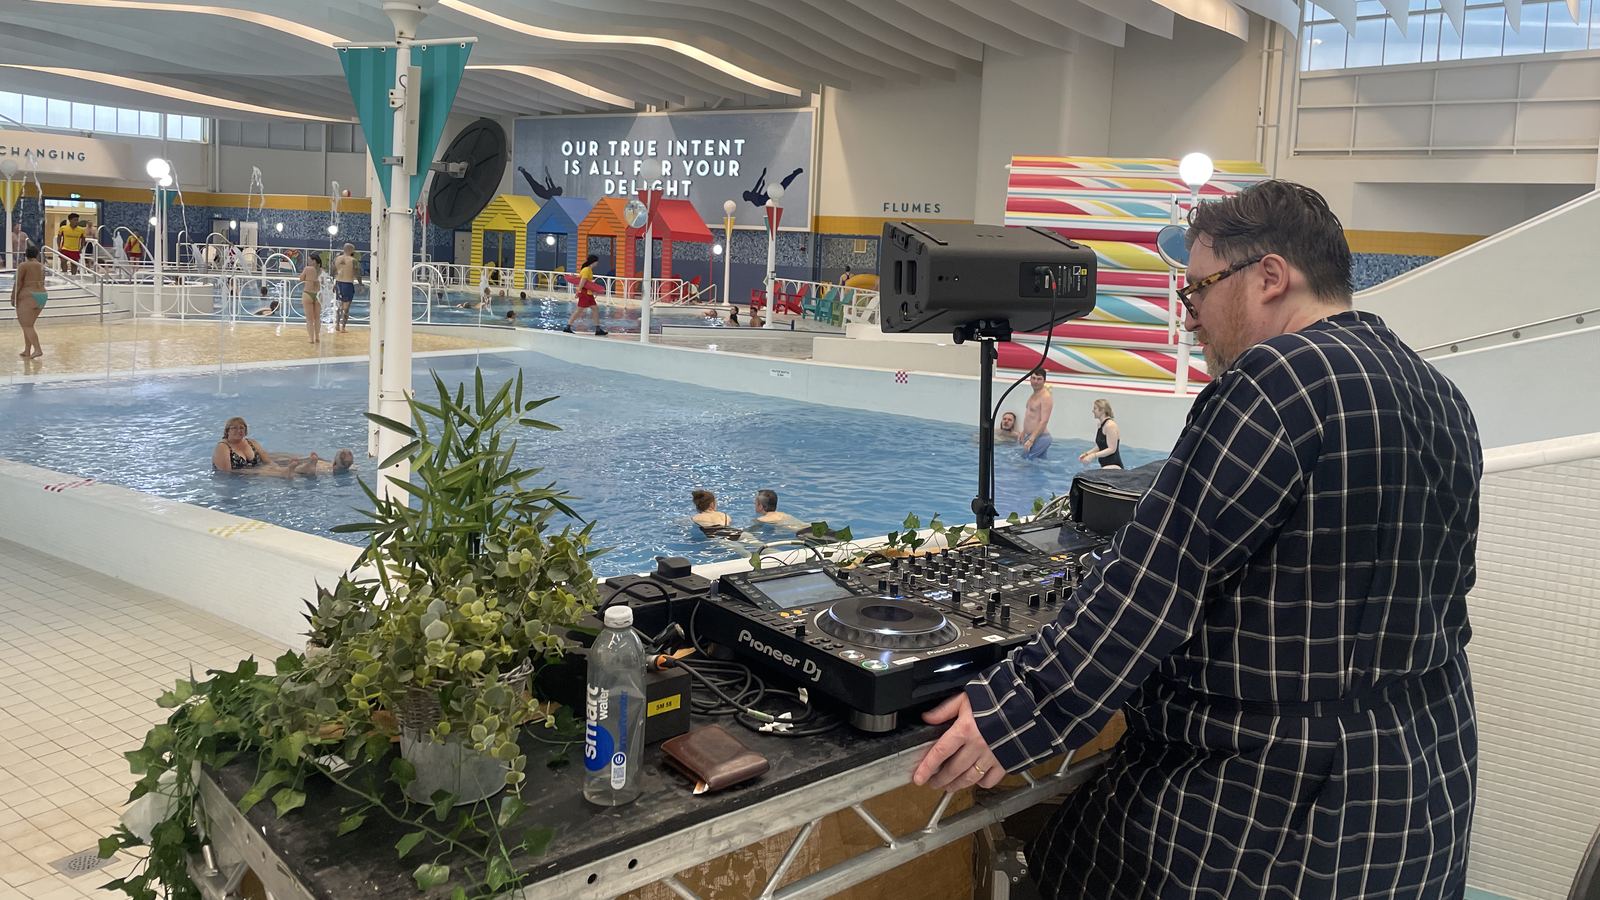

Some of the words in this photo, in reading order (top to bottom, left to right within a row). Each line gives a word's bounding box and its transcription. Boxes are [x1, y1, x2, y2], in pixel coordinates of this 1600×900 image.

[561, 140, 599, 156] OUR
[608, 140, 657, 156] TRUE
[668, 139, 746, 156] INTENT
[564, 159, 580, 175] IS
[589, 159, 624, 176] ALL
[633, 159, 672, 176] FR
[682, 159, 740, 177] YOUR
[604, 179, 692, 196] DELIGHT
[883, 202, 941, 213] FLUMES
[738, 629, 800, 668] Pioneer
[598, 687, 610, 720] water
